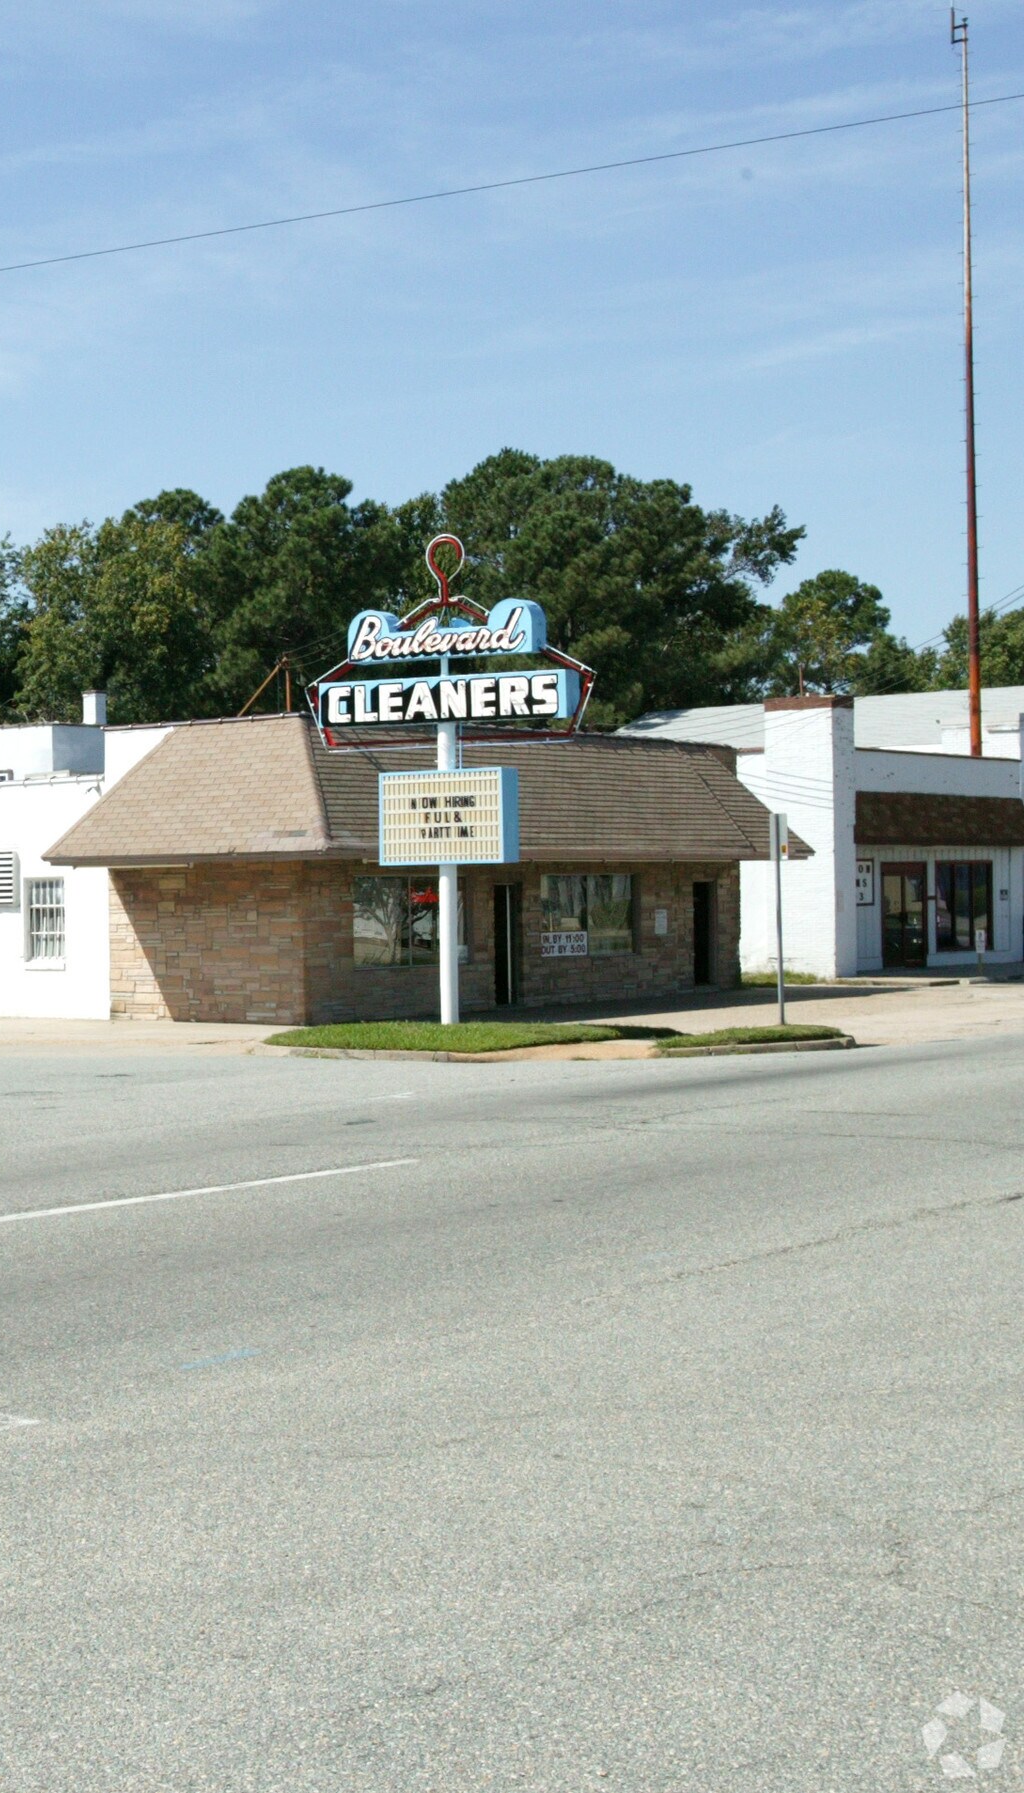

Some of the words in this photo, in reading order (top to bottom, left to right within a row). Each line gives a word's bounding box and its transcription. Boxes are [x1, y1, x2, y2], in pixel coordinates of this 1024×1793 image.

[350, 606, 526, 662] Boulevard
[326, 674, 559, 724] CLEANERS
[410, 797, 437, 809] NOW
[444, 795, 475, 808] HIRING
[541, 945, 555, 955] OUT
